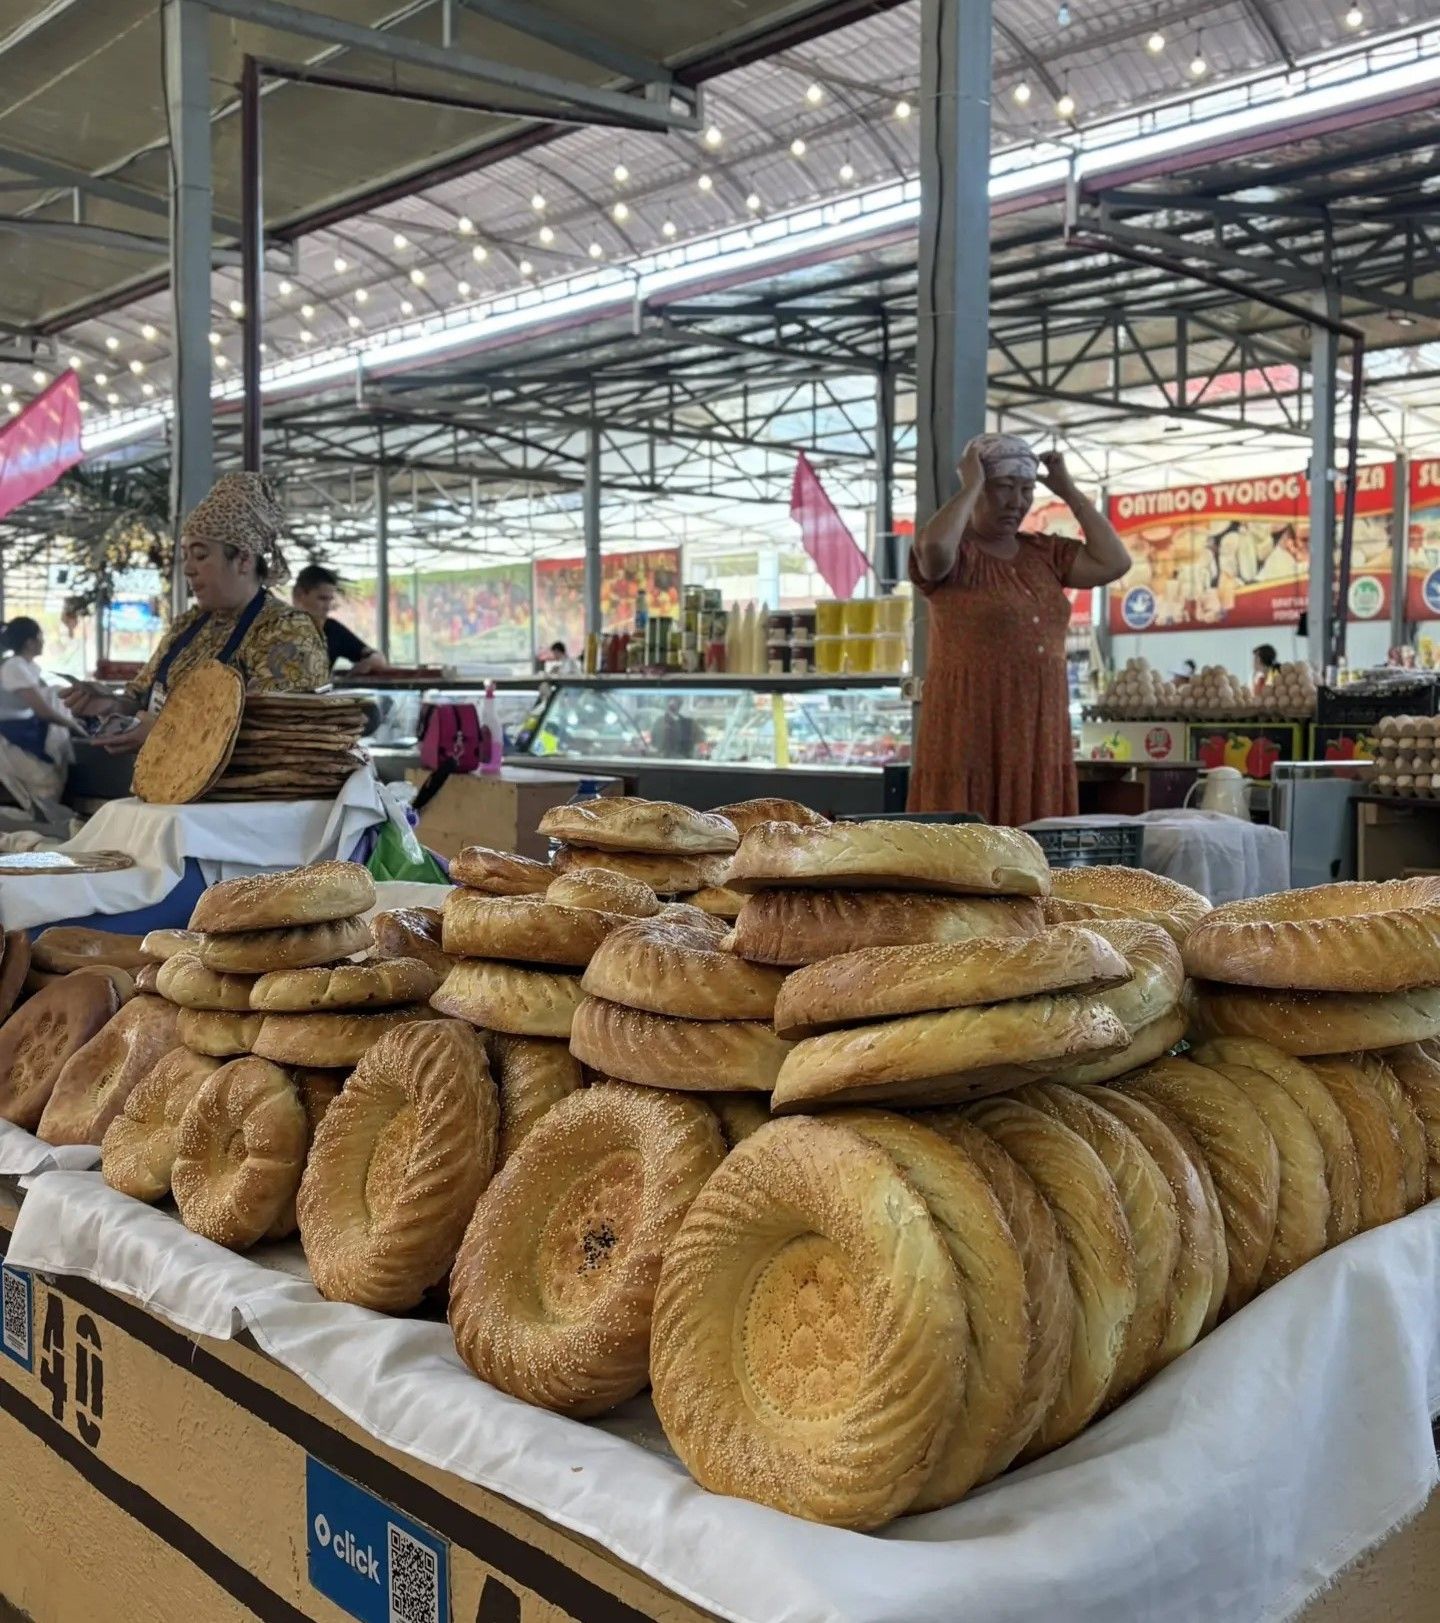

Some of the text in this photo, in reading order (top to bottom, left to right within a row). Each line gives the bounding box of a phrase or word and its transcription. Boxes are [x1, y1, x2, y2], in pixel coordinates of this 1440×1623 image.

[1212, 476, 1301, 507] TVOROG
[40, 1292, 104, 1449] 40
[333, 1530, 381, 1585] click
